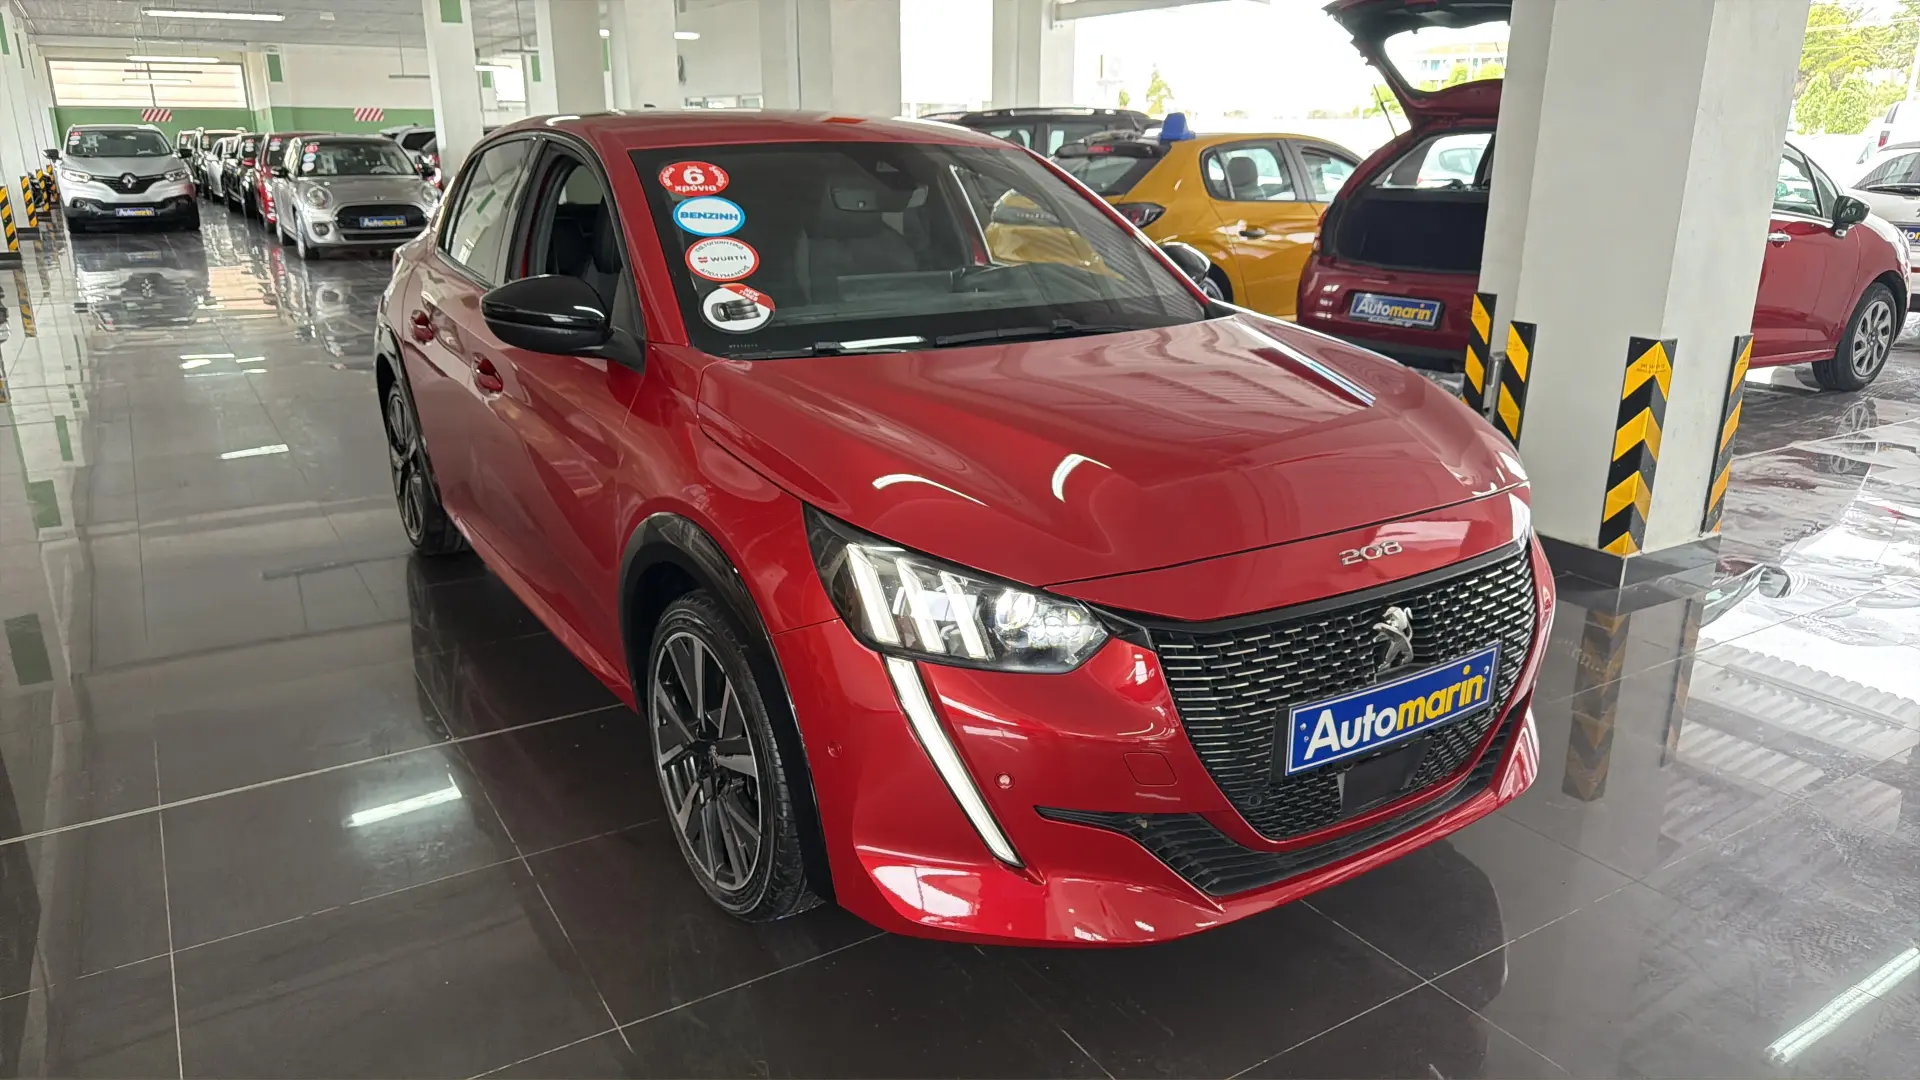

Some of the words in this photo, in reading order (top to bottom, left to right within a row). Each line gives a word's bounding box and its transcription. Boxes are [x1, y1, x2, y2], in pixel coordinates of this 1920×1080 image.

[674, 184, 717, 193] χρόνια
[683, 168, 705, 185] 6
[1356, 297, 1432, 321] Automarin
[1339, 540, 1403, 566] 208
[1303, 664, 1484, 761] Automarin
